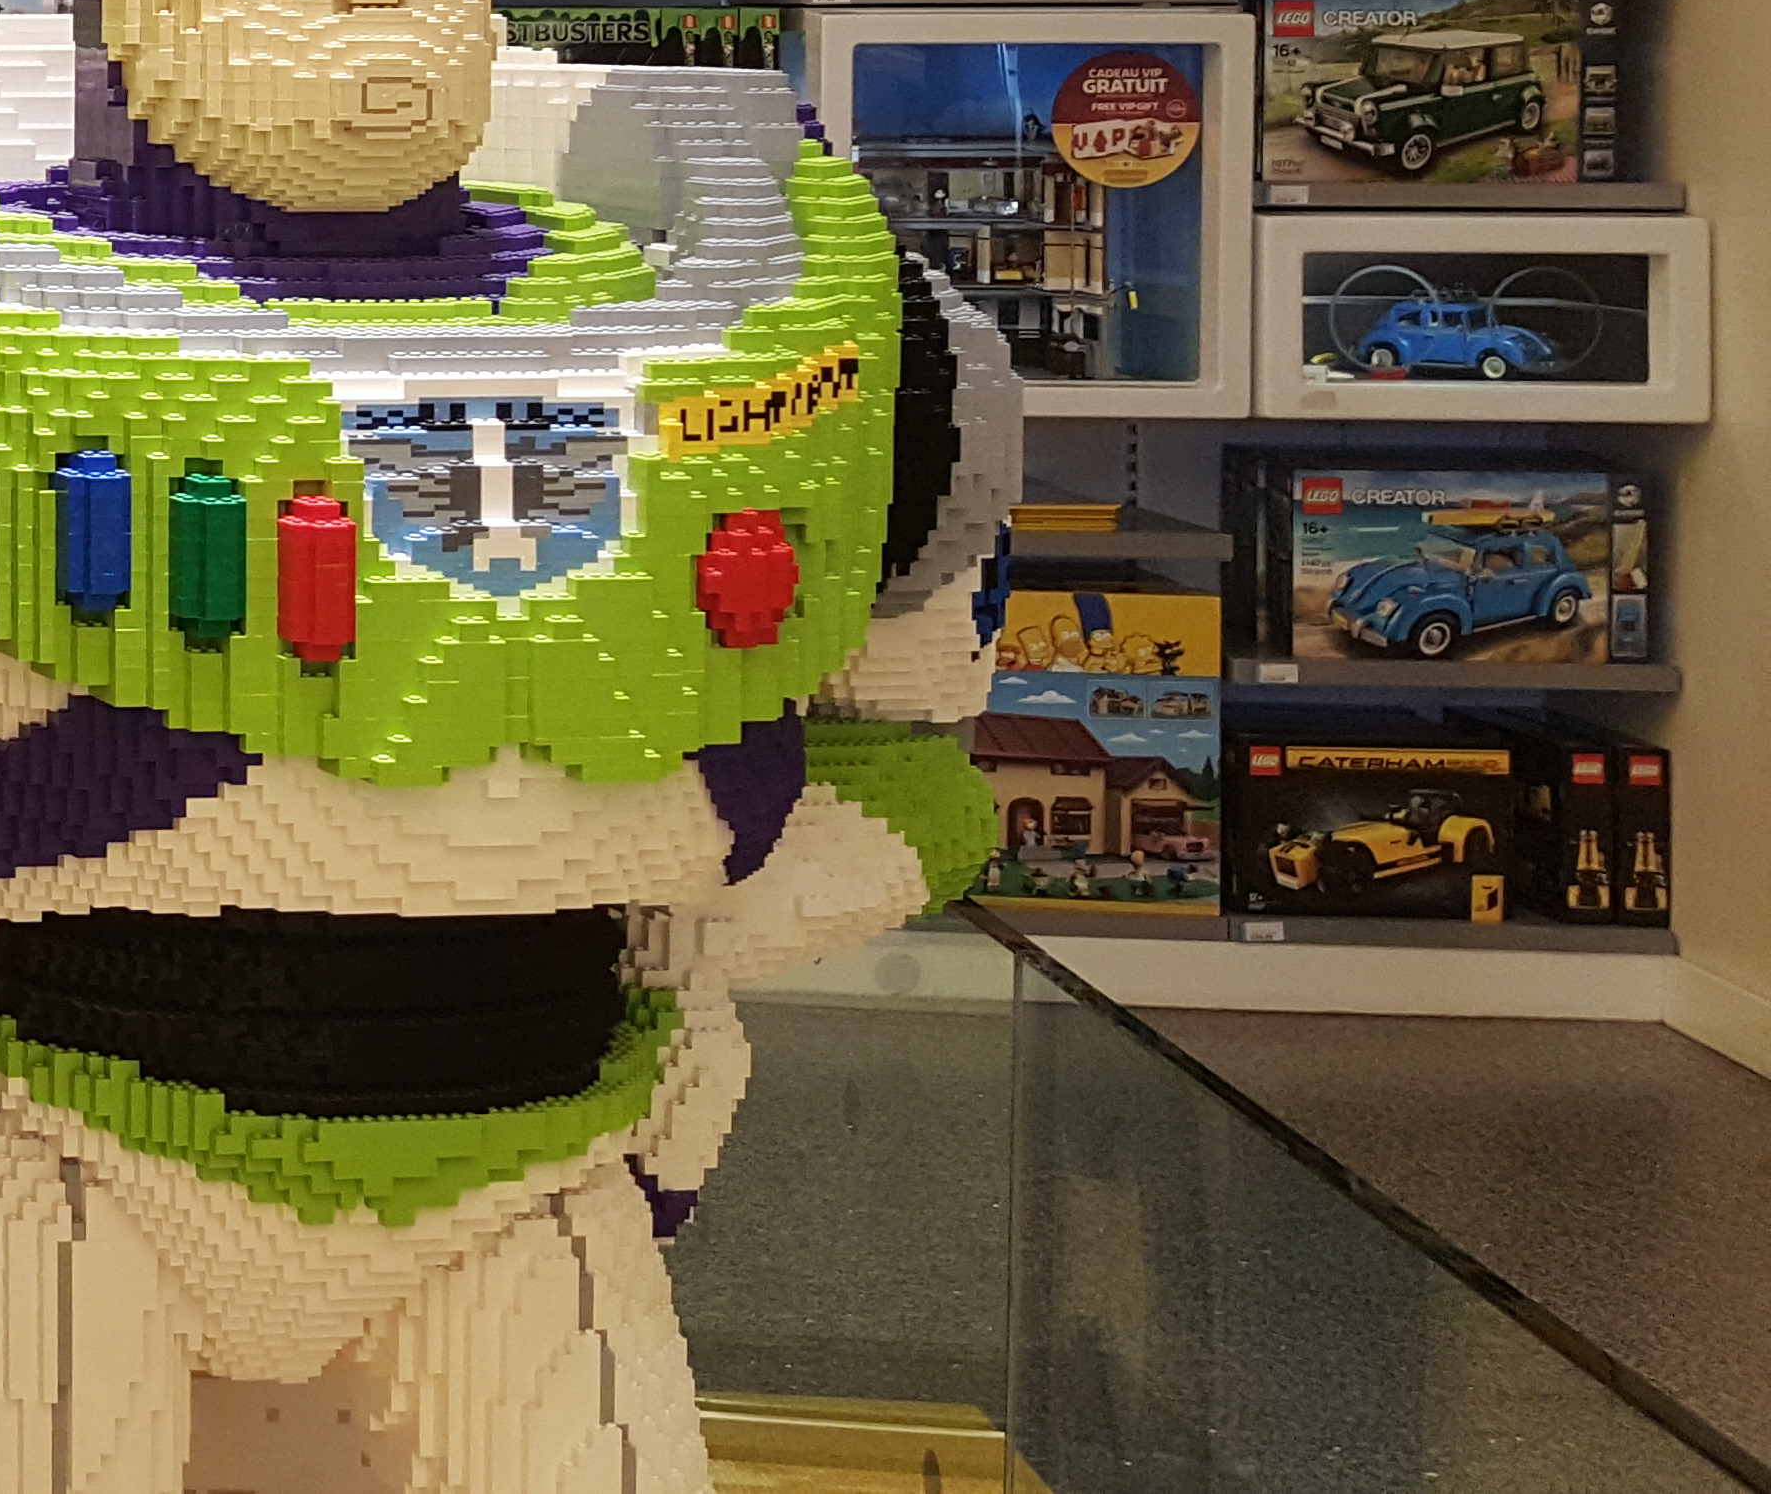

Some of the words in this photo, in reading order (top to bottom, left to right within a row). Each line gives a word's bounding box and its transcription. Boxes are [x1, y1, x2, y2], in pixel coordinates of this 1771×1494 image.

[1277, 11, 1311, 25] LEGO
[1322, 10, 1418, 27] CREATOR
[1272, 43, 1301, 57] 16+
[1088, 67, 1140, 79] CADEAU
[1141, 67, 1163, 78] VIP
[1081, 77, 1169, 94] GRATUIT
[1351, 488, 1446, 506] CREATOR
[1298, 756, 1446, 770] CATERHAM
